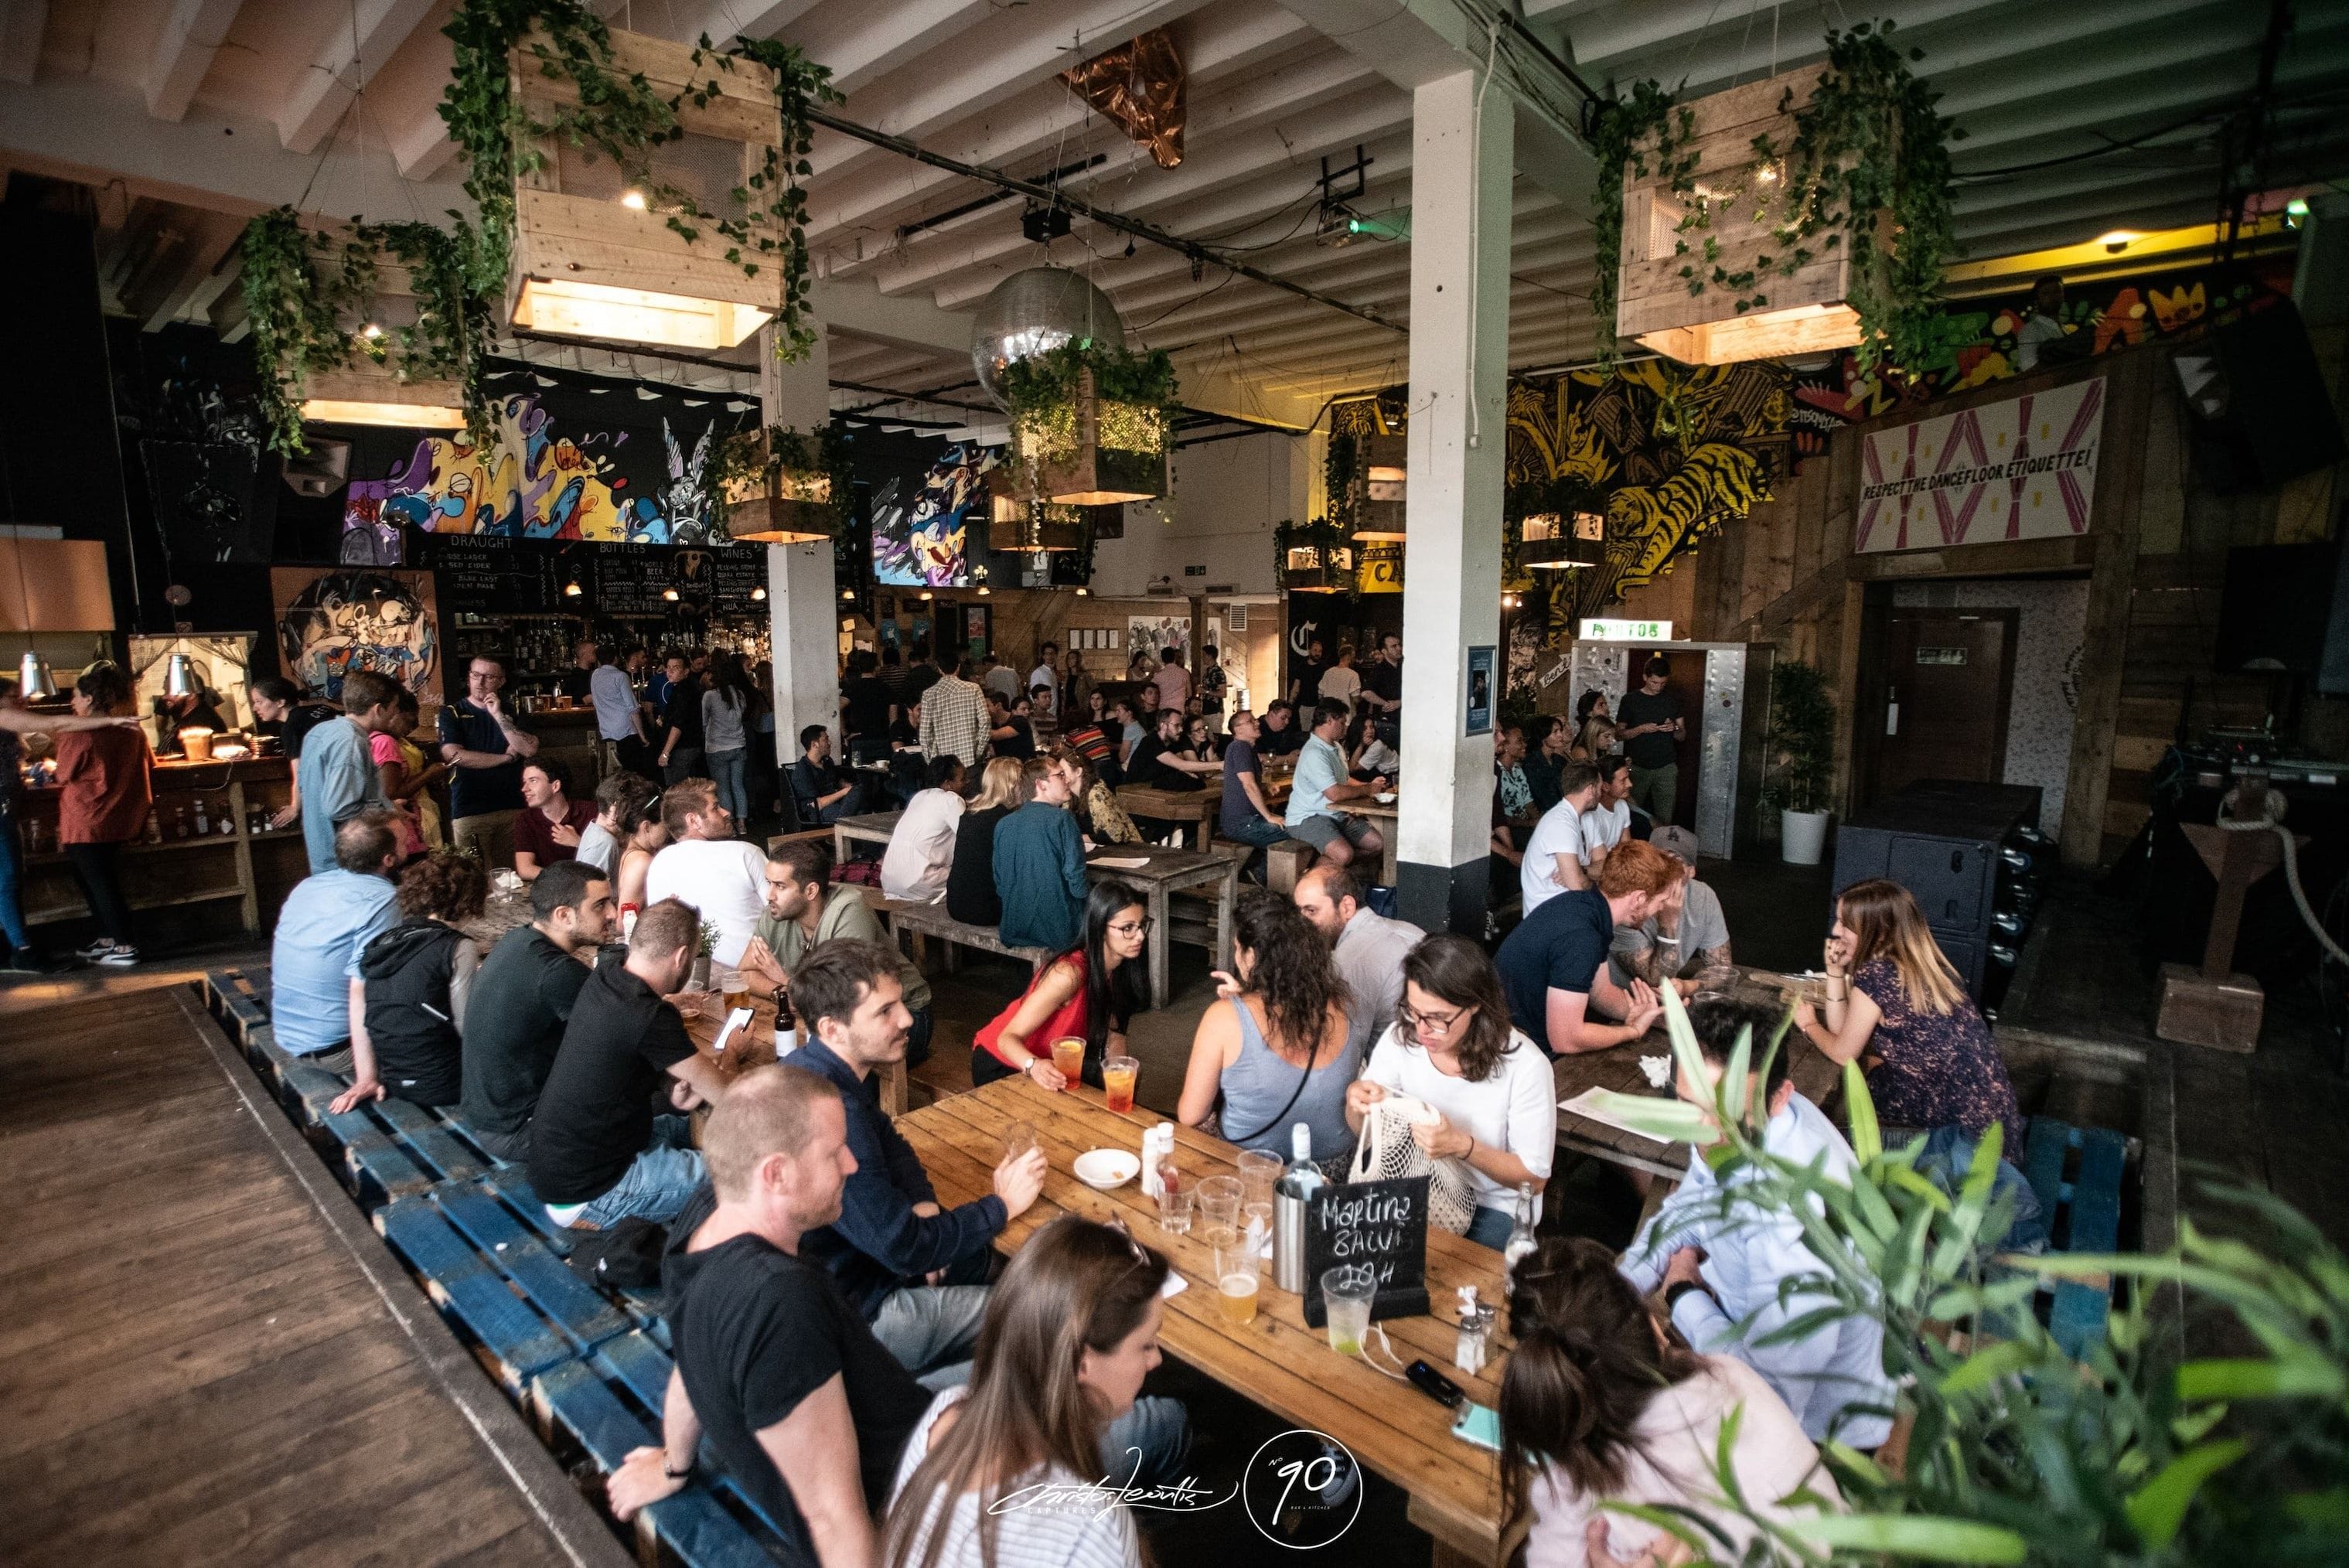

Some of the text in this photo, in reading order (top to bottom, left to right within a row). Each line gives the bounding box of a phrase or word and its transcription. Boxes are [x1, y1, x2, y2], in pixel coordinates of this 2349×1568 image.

[1863, 448, 2092, 500] RESPECT THE DANCEFLOOR ETIQUETTE!
[451, 535, 512, 549] DRAUGHT
[599, 543, 646, 554] BOTTLES
[721, 548, 753, 560] WINES
